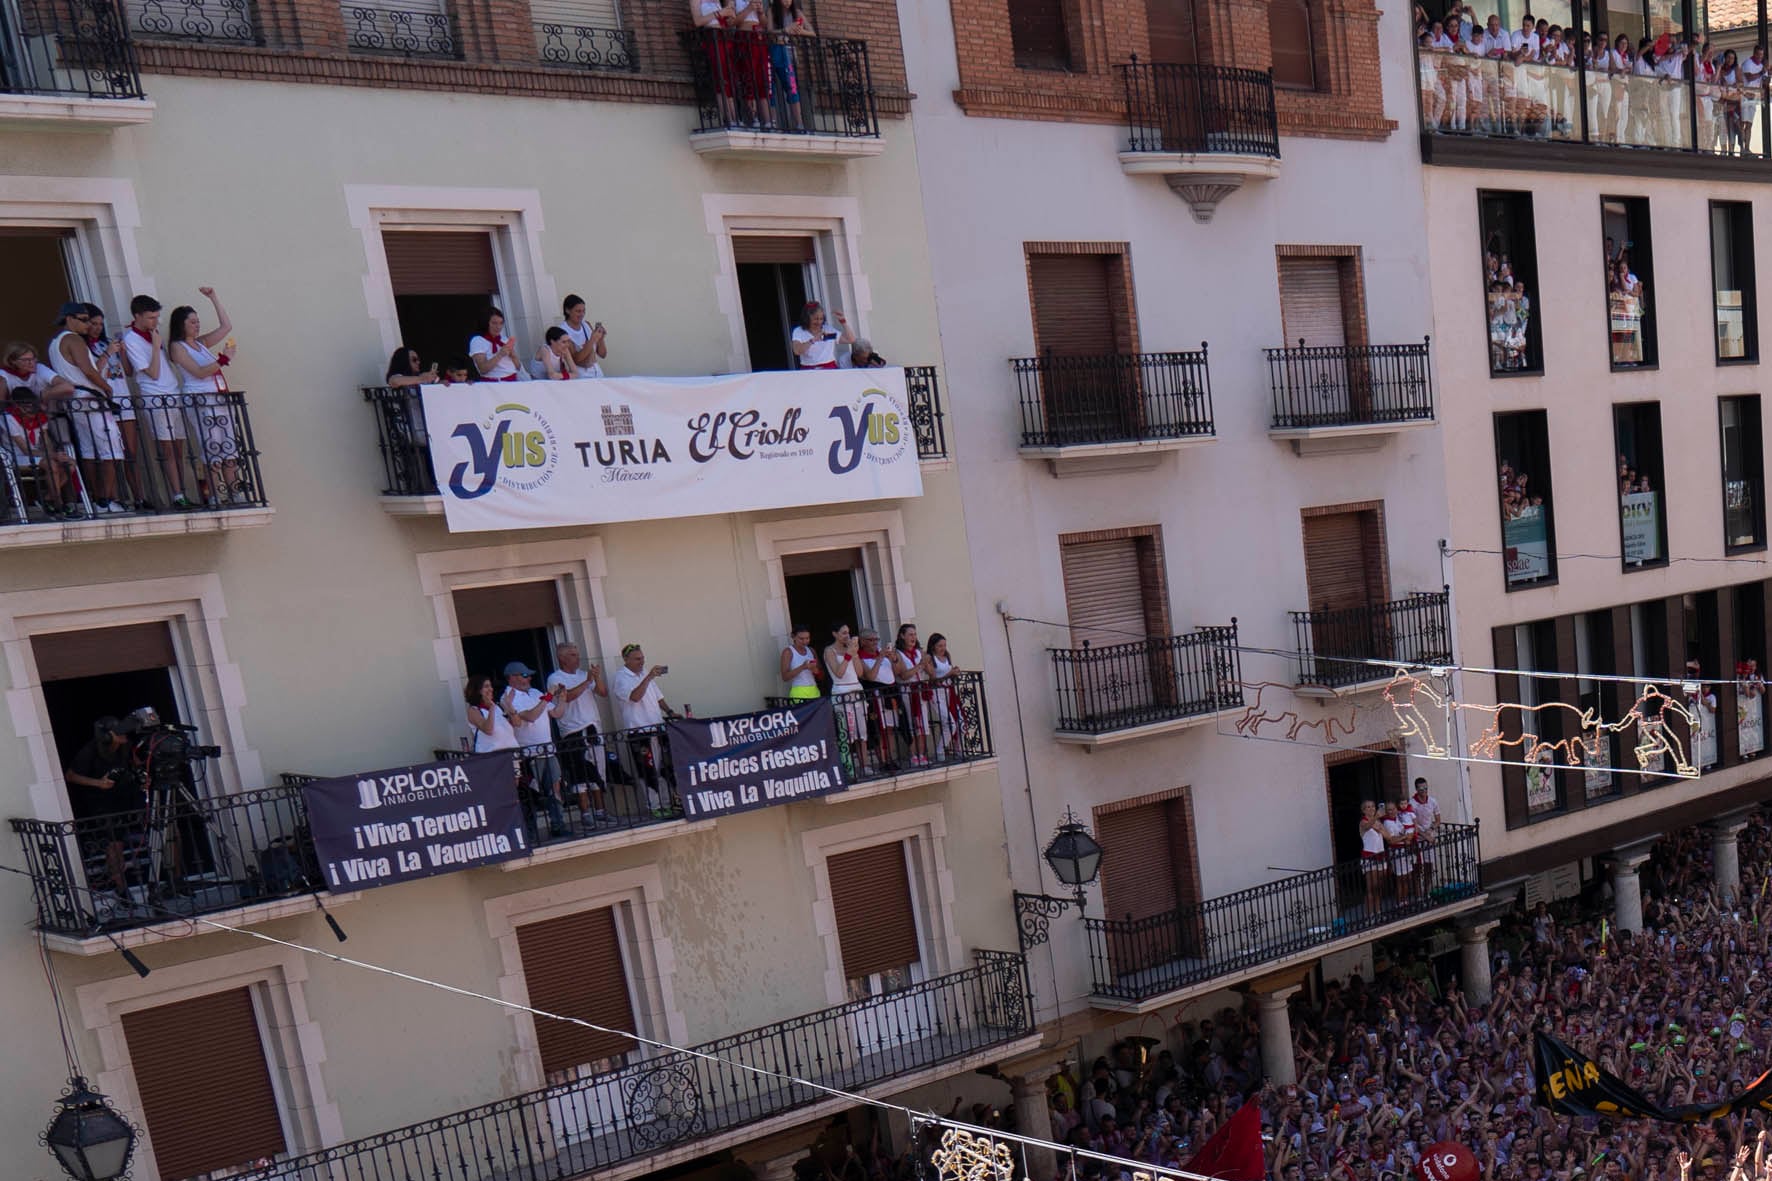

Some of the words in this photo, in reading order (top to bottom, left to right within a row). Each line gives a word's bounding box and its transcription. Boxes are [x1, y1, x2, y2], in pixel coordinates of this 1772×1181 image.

[687, 411, 727, 463] El
[727, 407, 810, 461] Criollo
[828, 402, 901, 475] Yus
[449, 419, 547, 500] Yus
[574, 438, 673, 468] TURIA
[799, 447, 815, 457] 1910
[727, 710, 799, 737] XPLORA
[729, 726, 799, 746] INMOBILIARIA
[380, 765, 471, 797] XPLORA
[382, 783, 473, 806] INMOBILIARIA
[739, 784, 760, 805] La
[397, 850, 423, 874] La
